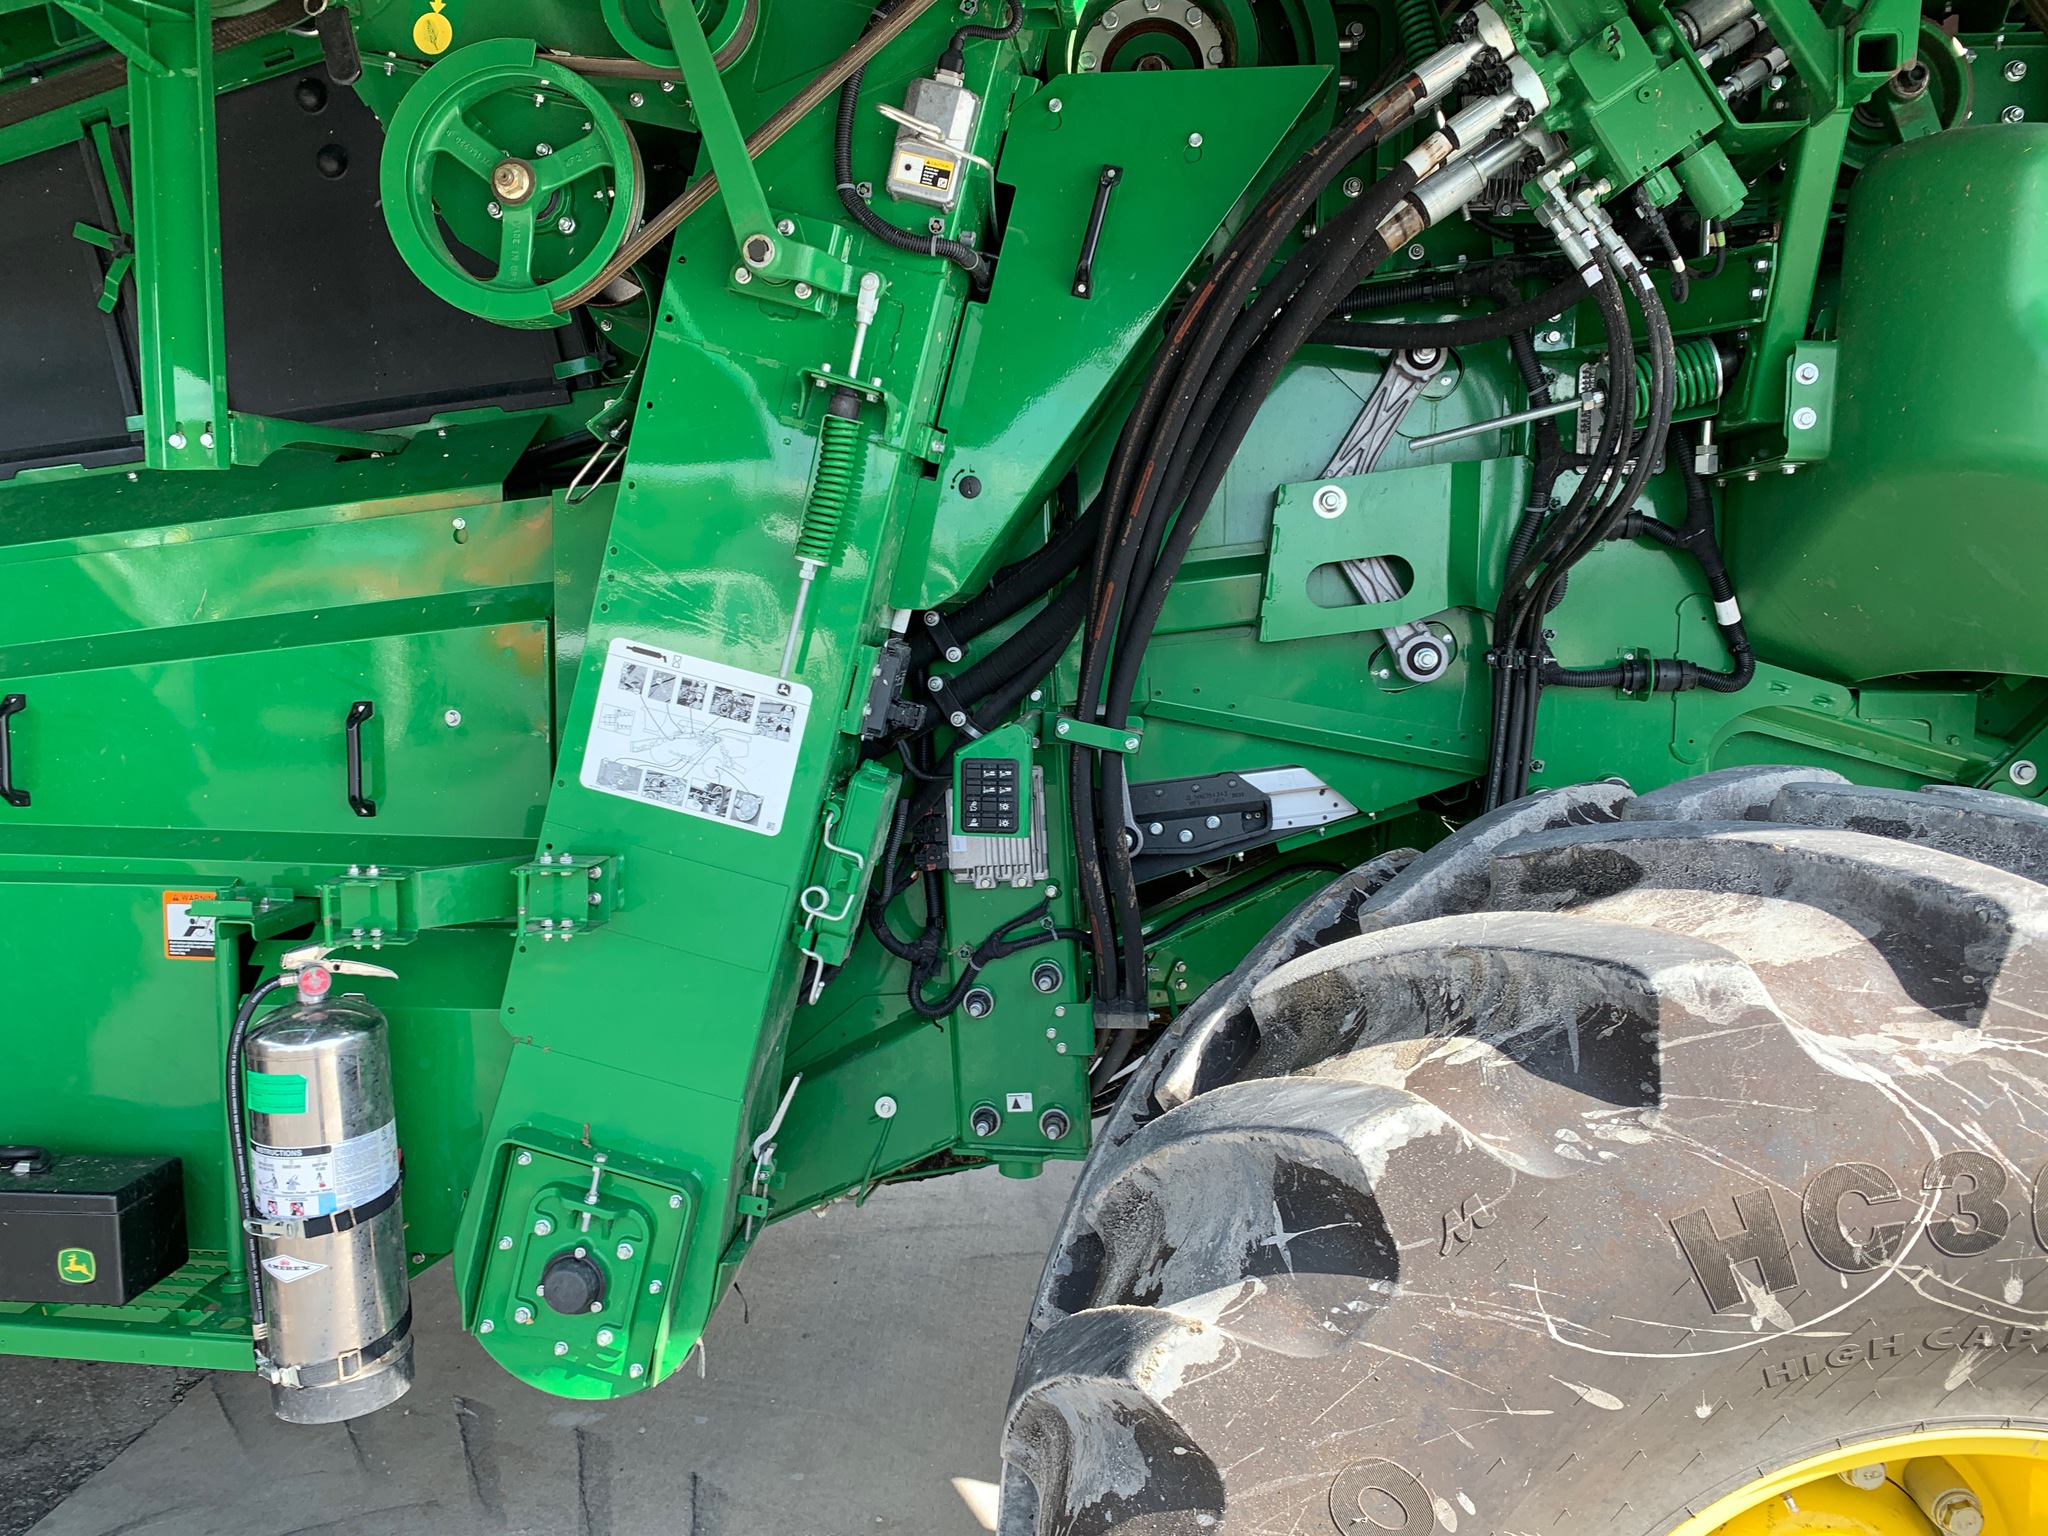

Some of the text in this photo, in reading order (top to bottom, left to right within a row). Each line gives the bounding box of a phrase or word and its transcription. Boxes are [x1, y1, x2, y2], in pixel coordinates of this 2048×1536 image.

[1668, 1149, 2048, 1314] HC3
[268, 1263, 311, 1271] AMEREX
[1761, 1324, 2048, 1389] HIGH CAP
